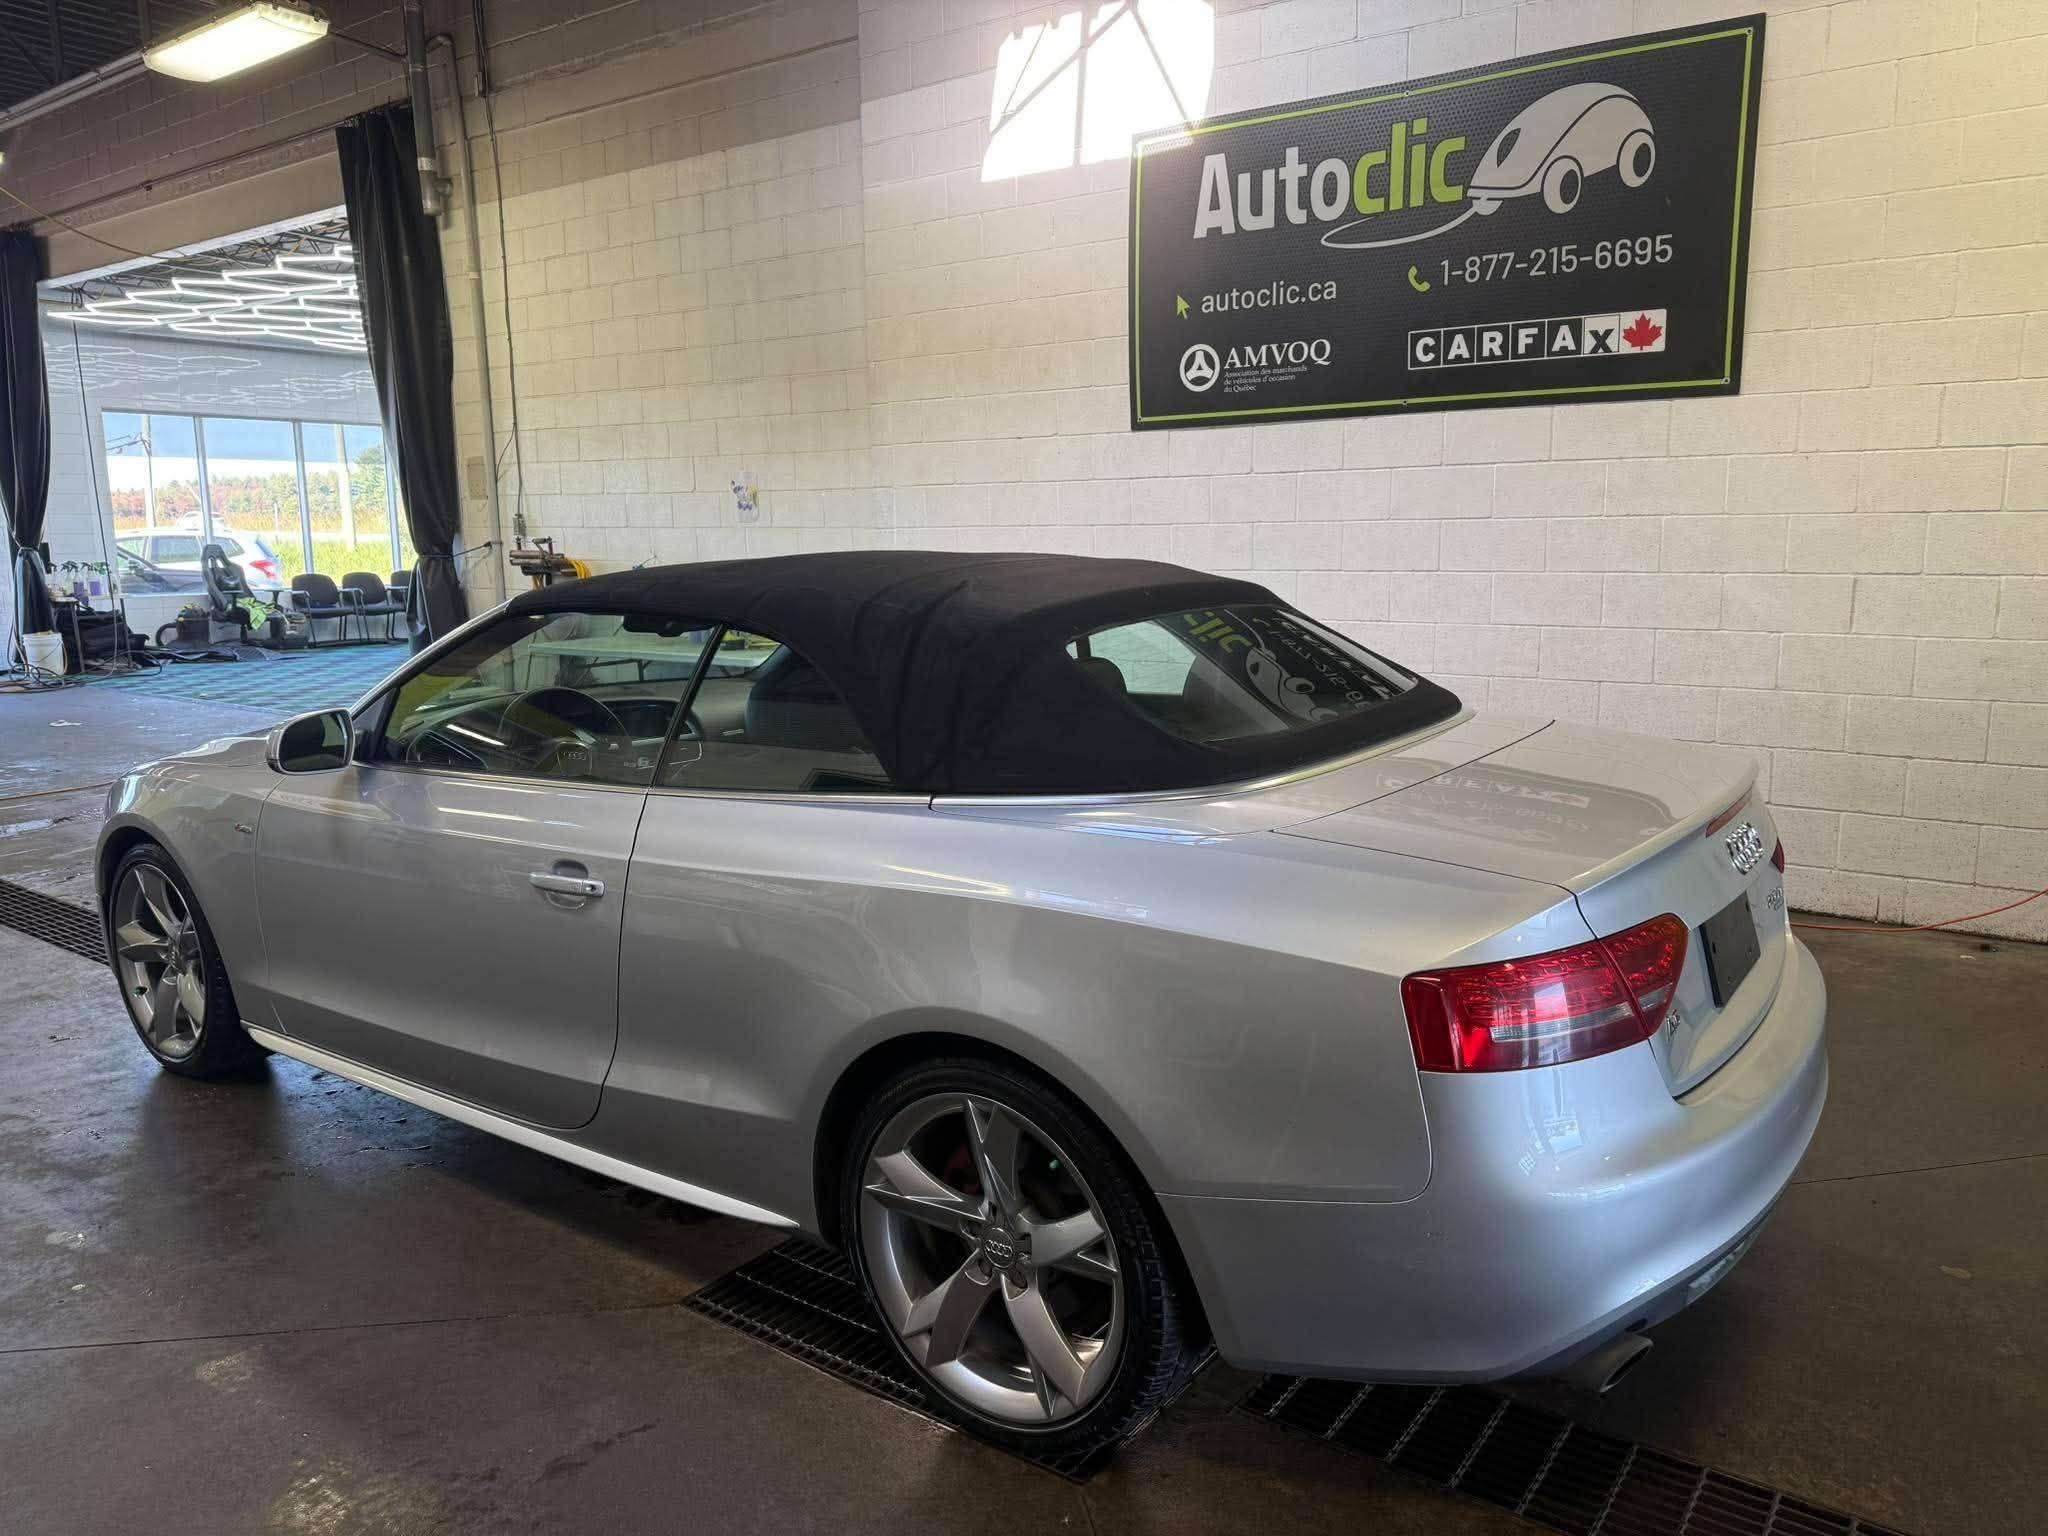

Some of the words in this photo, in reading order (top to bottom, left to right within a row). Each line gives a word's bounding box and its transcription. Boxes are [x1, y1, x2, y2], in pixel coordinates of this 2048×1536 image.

[1193, 117, 1466, 239] Autoclic
[1440, 233, 1673, 286] 1-877-215-6695
[1201, 280, 1337, 313] autoclic.ca
[1224, 338, 1332, 369] AMVOQ
[1415, 324, 1615, 363] CARFAX
[1261, 367, 1271, 375] des
